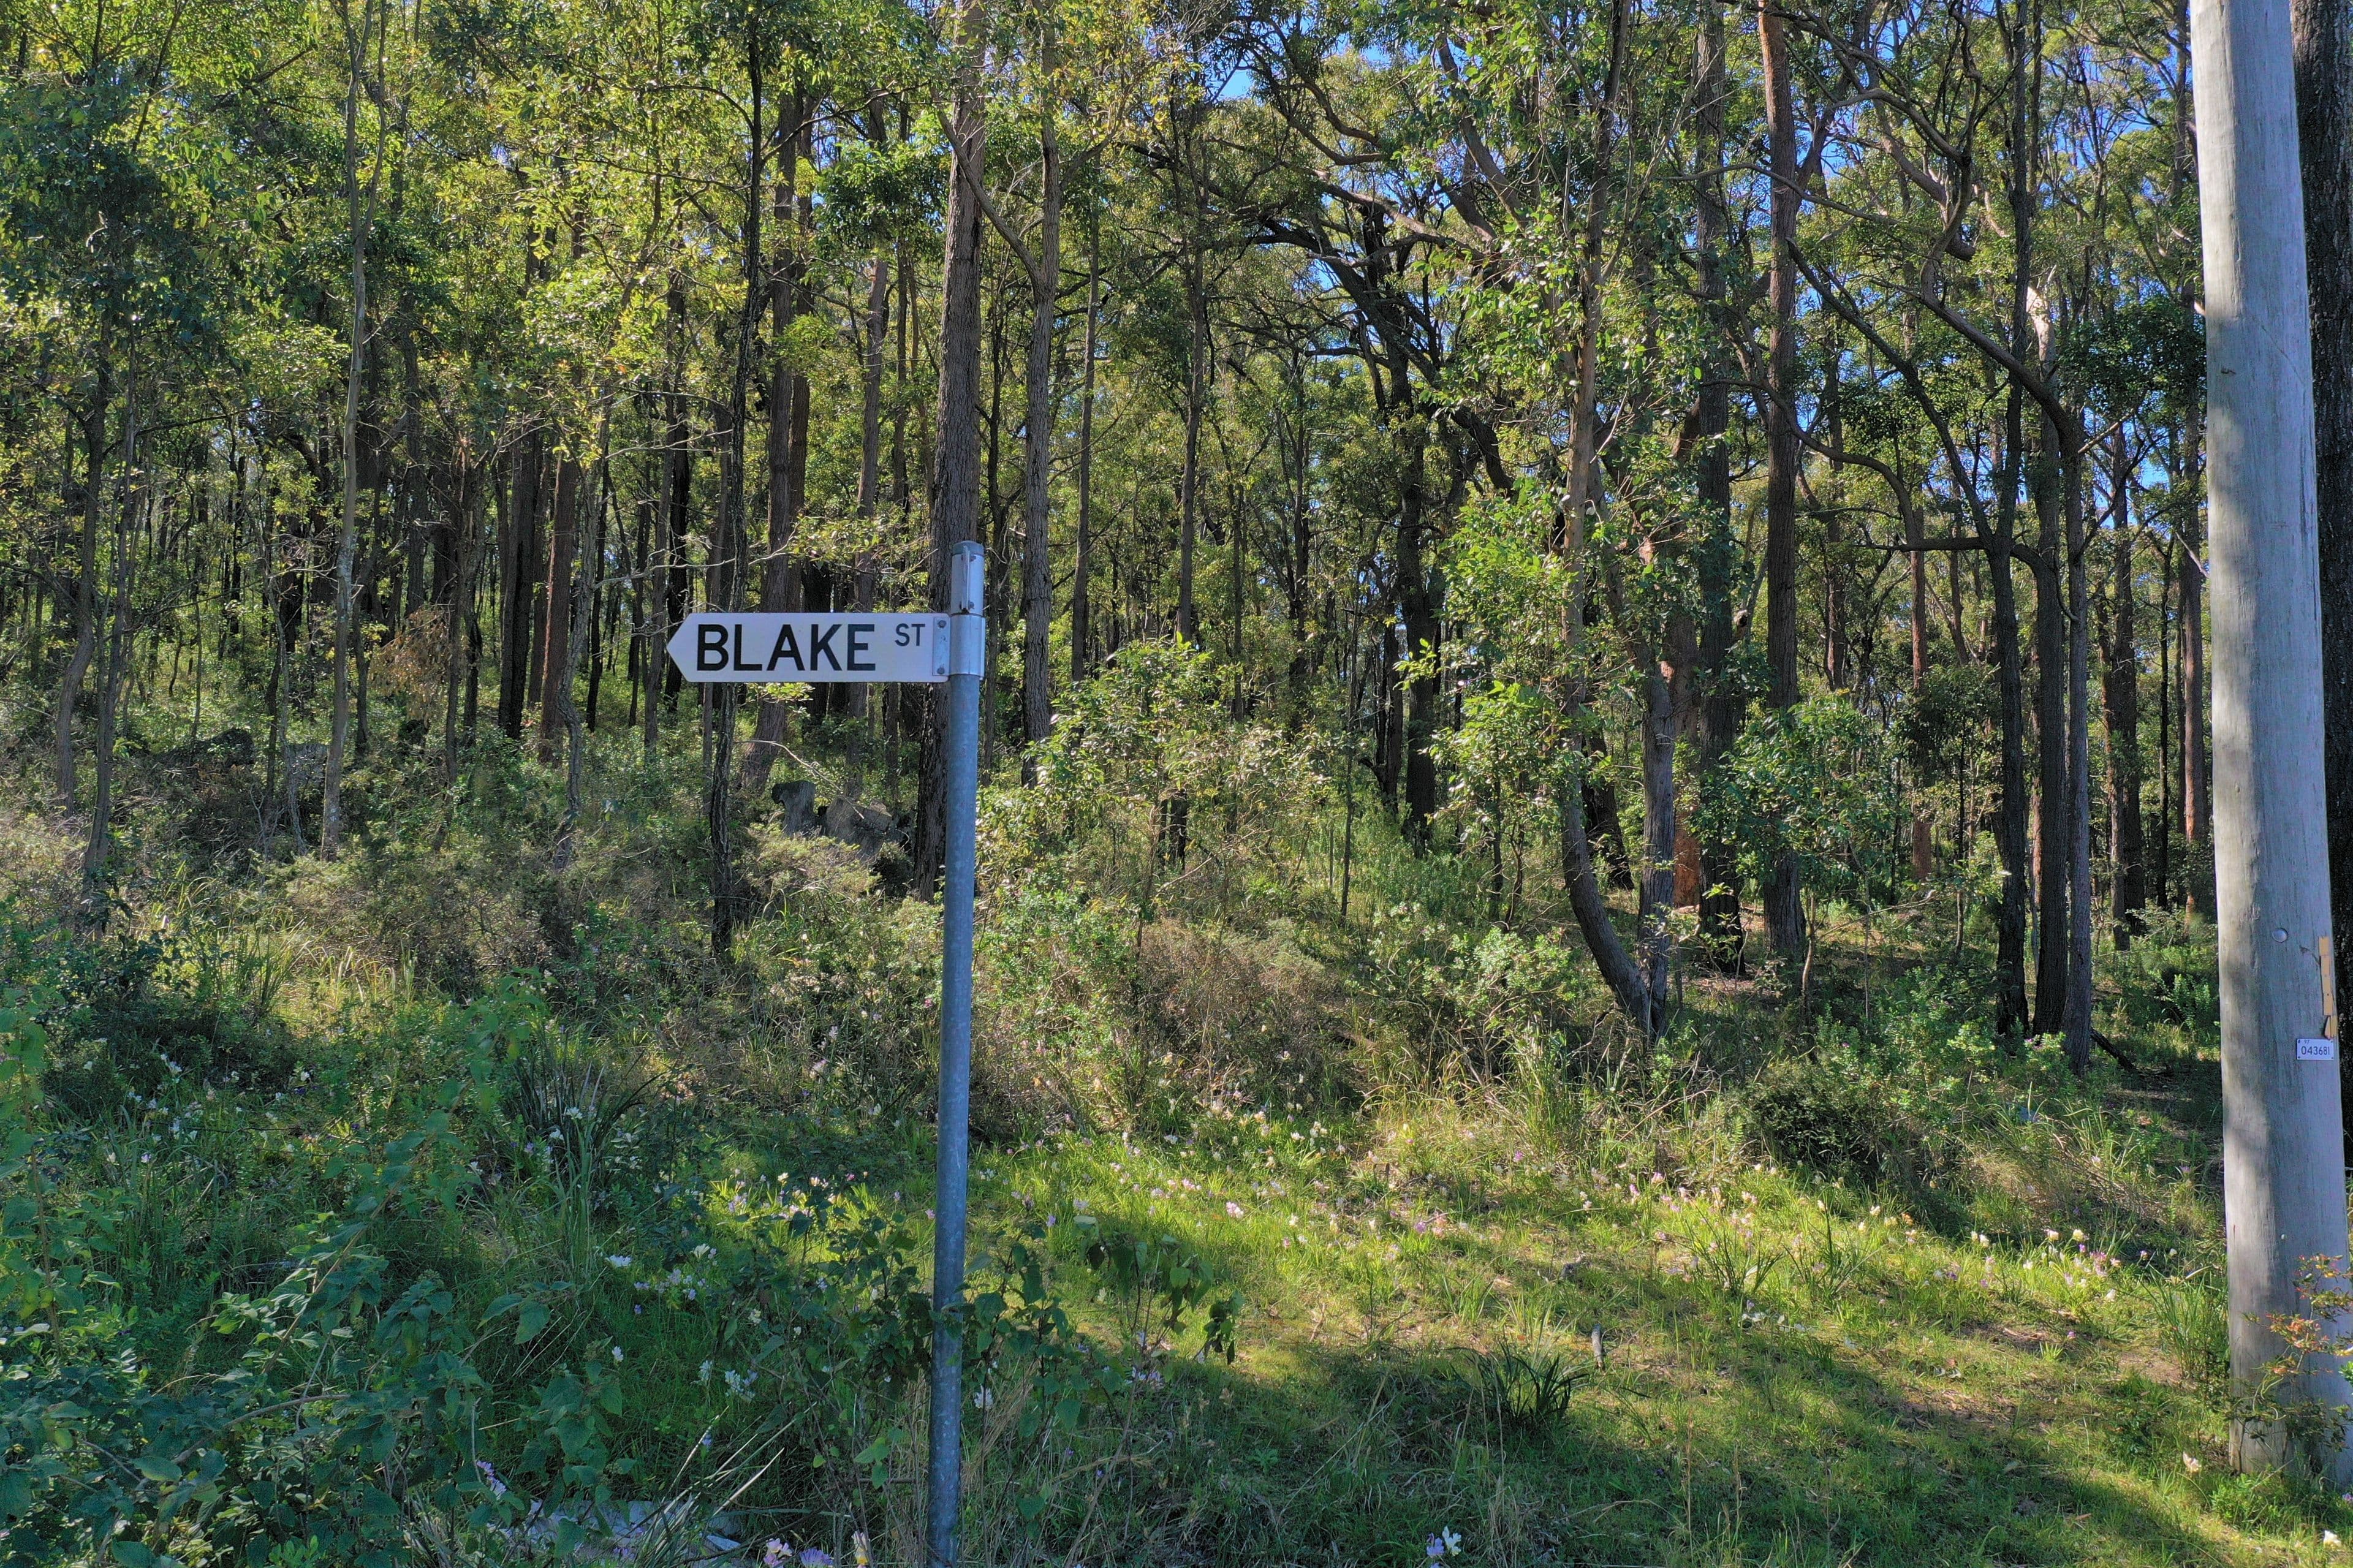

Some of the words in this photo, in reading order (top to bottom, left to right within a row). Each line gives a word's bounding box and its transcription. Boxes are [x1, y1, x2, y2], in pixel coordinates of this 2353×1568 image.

[696, 624, 876, 672] BLAKE
[895, 623, 925, 646] ST
[2301, 1046, 2330, 1055] 043681
